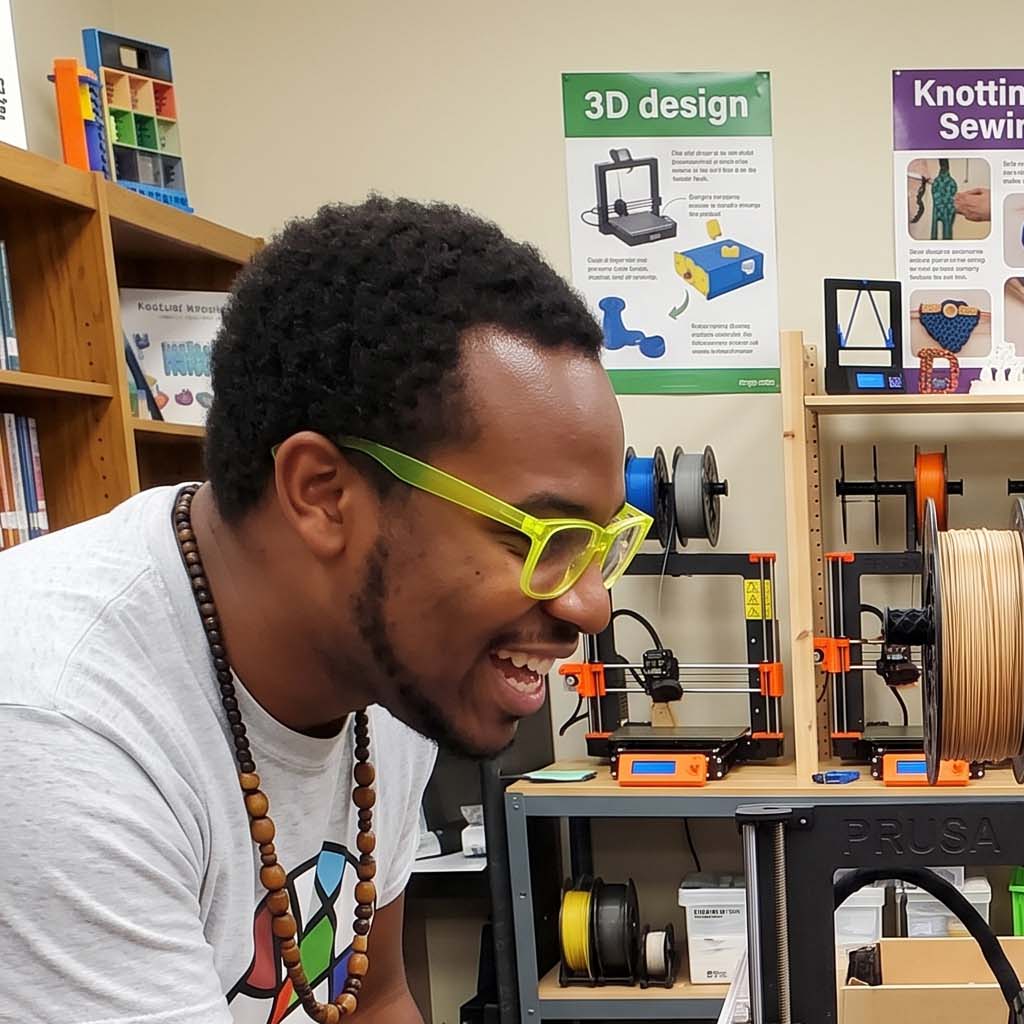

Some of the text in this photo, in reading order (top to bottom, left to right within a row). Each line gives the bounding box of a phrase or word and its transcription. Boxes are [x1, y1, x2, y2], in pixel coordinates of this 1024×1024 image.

[584, 88, 749, 126] 3D design
[842, 817, 1001, 855] PRUSA
